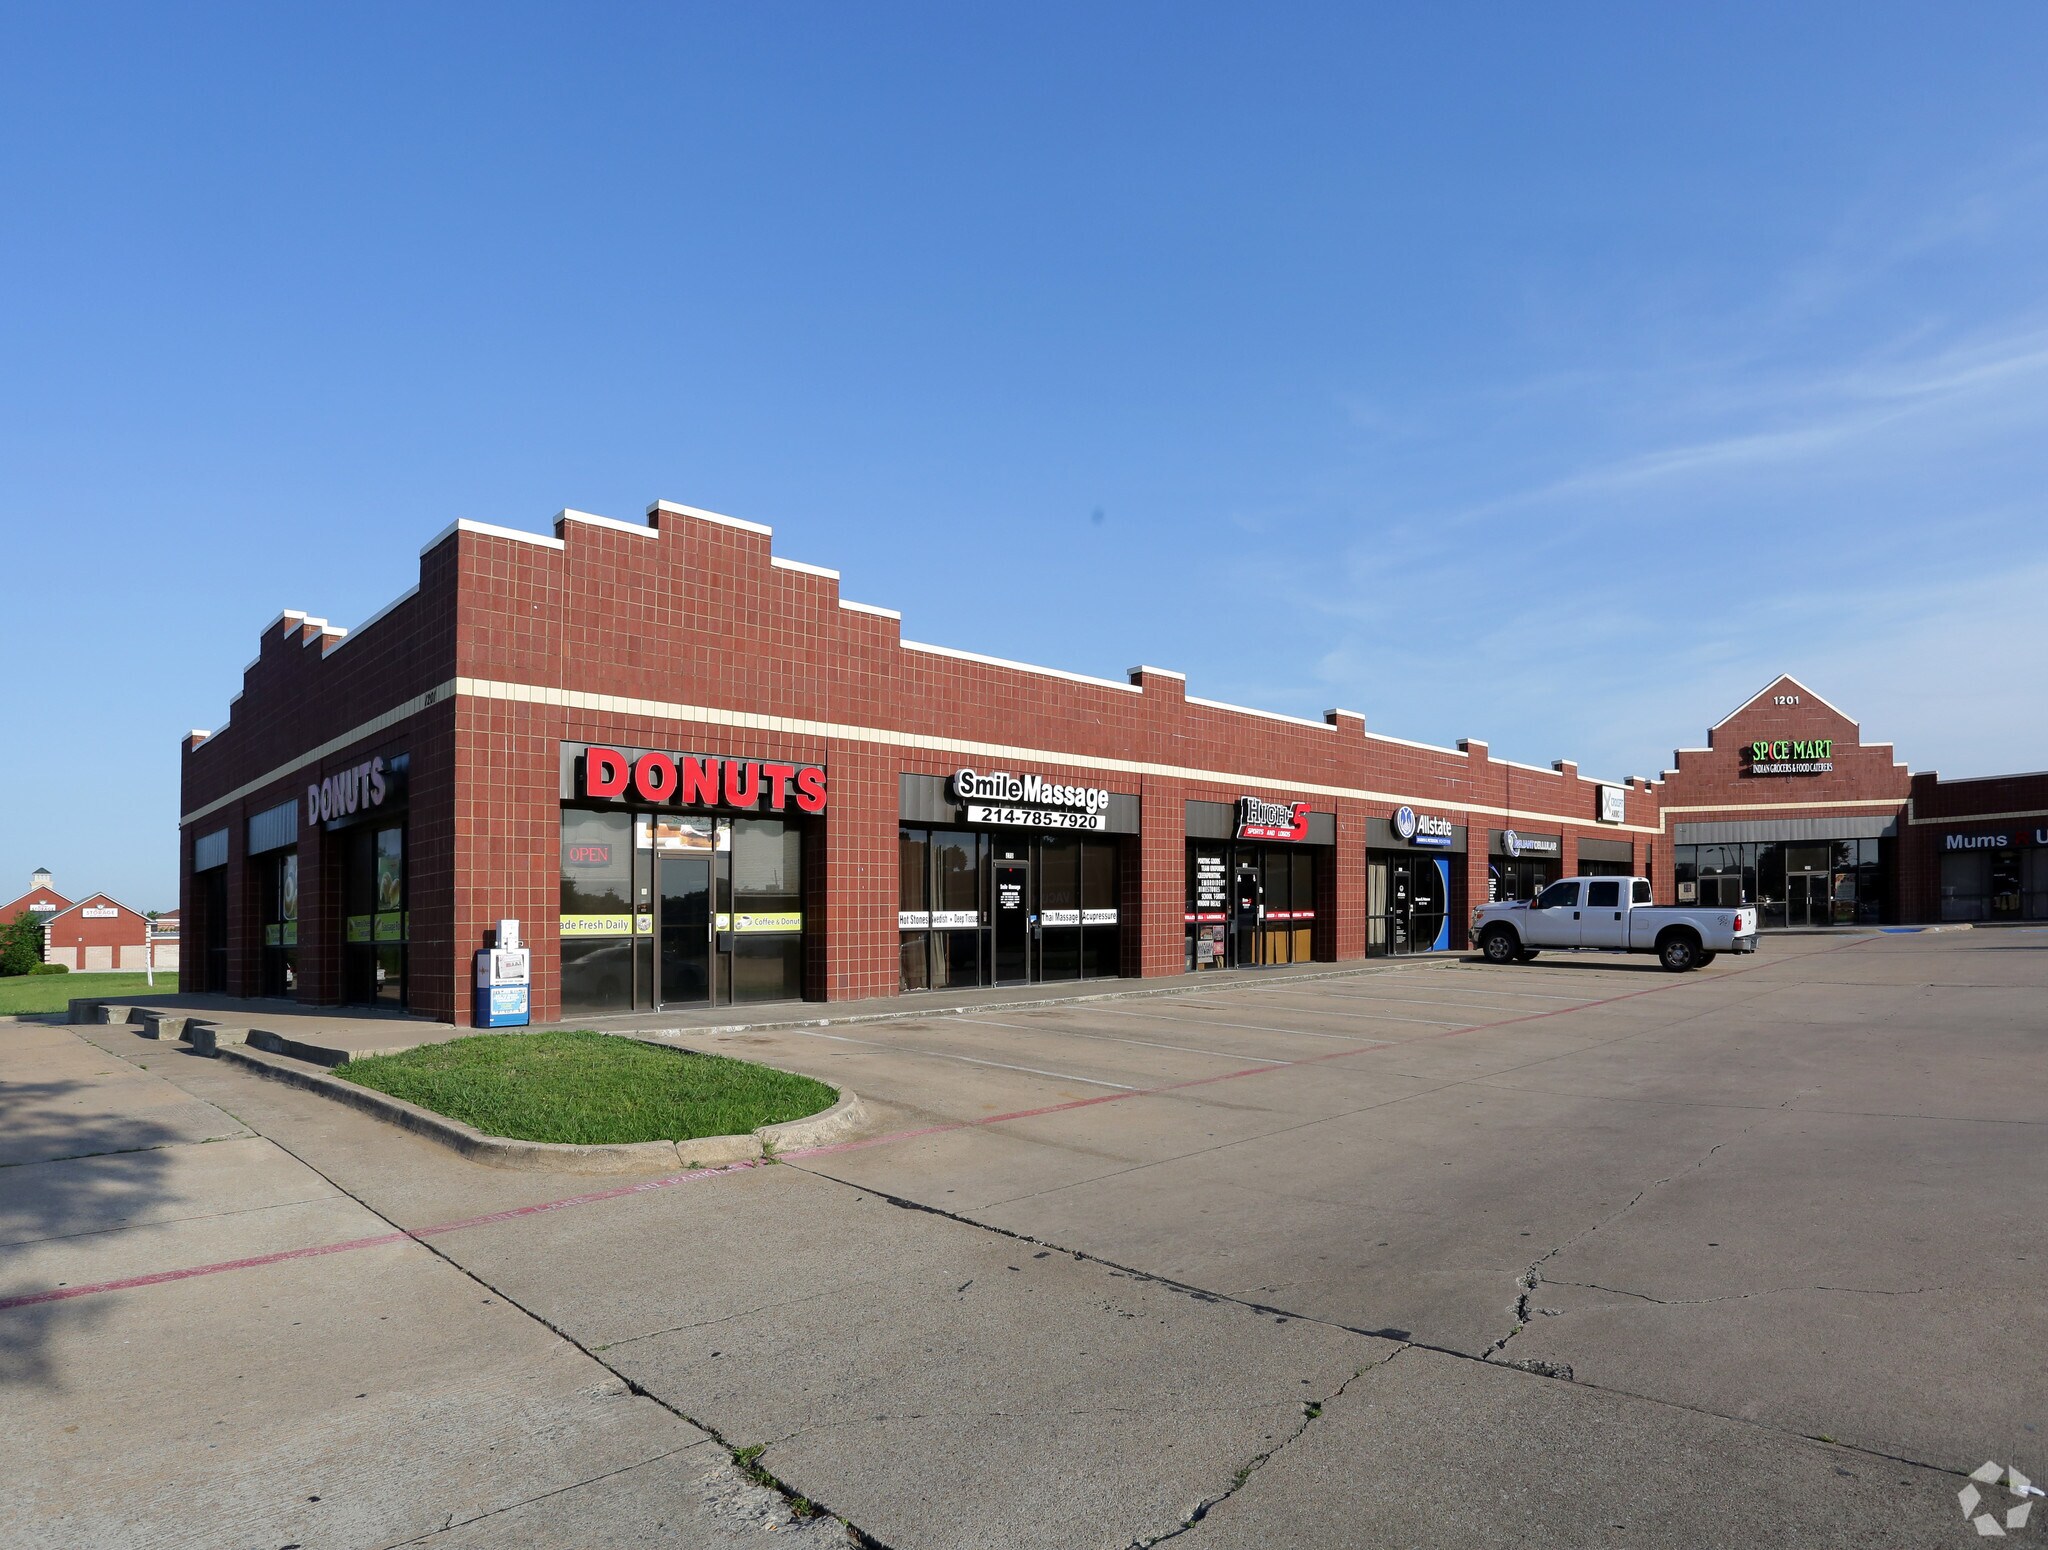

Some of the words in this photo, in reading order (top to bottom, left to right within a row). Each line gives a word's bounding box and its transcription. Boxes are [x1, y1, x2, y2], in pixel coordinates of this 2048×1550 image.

[1773, 695, 1799, 705] 1201
[1752, 741, 1790, 761] SPICE
[1793, 740, 1833, 760] MART
[1752, 764, 1770, 774] INDIAN
[1770, 763, 1792, 773] GROCERS
[1796, 763, 1809, 773] FOOD
[587, 746, 827, 812] DONUTS
[307, 755, 386, 826] DONUTS
[981, 808, 1098, 828] 214-785-7920
[1416, 814, 1452, 836] Allstate
[1247, 827, 1264, 836] SPORTS
[1946, 834, 2008, 850] Mums
[569, 847, 609, 862] OPEN
[754, 917, 775, 926] Coffee
[899, 914, 909, 925] Hot
[910, 914, 929, 925] Stones
[954, 913, 965, 925] Deep
[1041, 912, 1054, 922] Thai
[1055, 912, 1079, 924] Massage
[1081, 911, 1117, 923] Acupressure
[578, 919, 604, 930] Fresh
[605, 919, 629, 932] Daily
